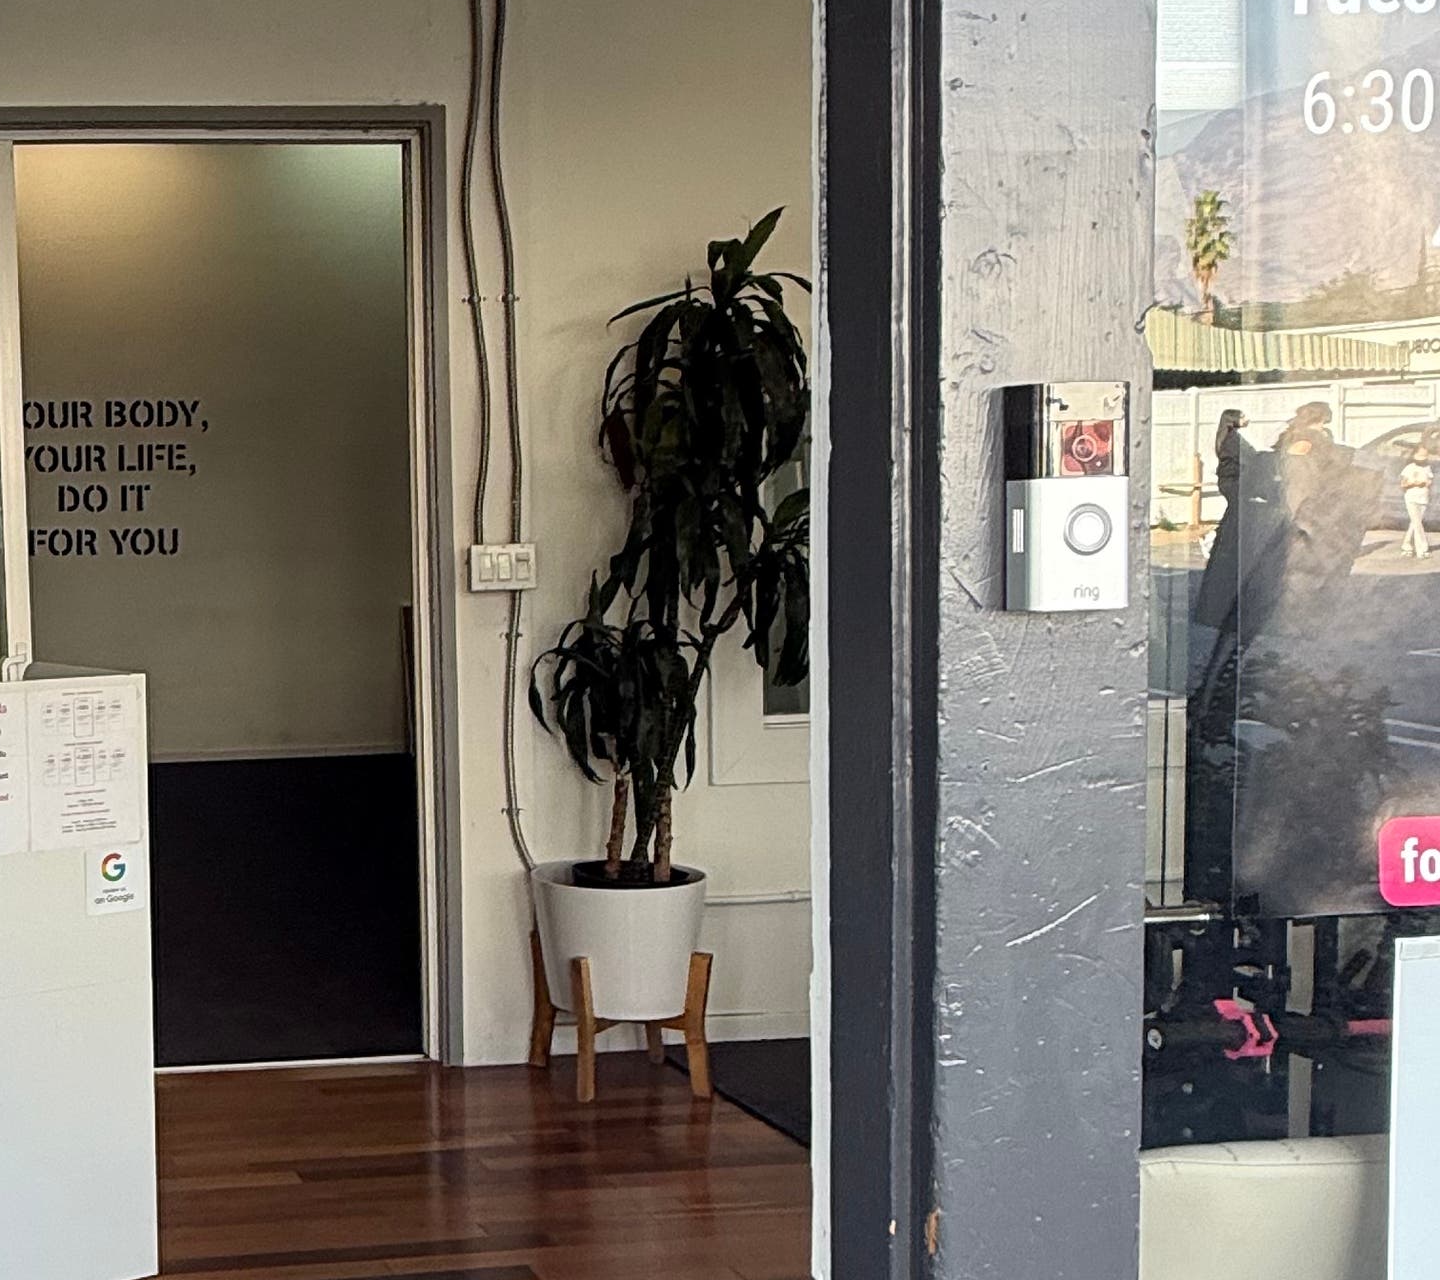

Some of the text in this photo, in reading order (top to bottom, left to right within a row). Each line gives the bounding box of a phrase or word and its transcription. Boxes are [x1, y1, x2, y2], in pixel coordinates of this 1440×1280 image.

[1303, 68, 1435, 135] 6:30
[105, 400, 209, 432] BODY,
[118, 444, 196, 476] LIFE,
[58, 485, 151, 513] DO IT
[29, 528, 179, 556] FOR YOU
[1073, 584, 1100, 601] ring
[1400, 836, 1440, 883] fo
[106, 892, 134, 903] Google
